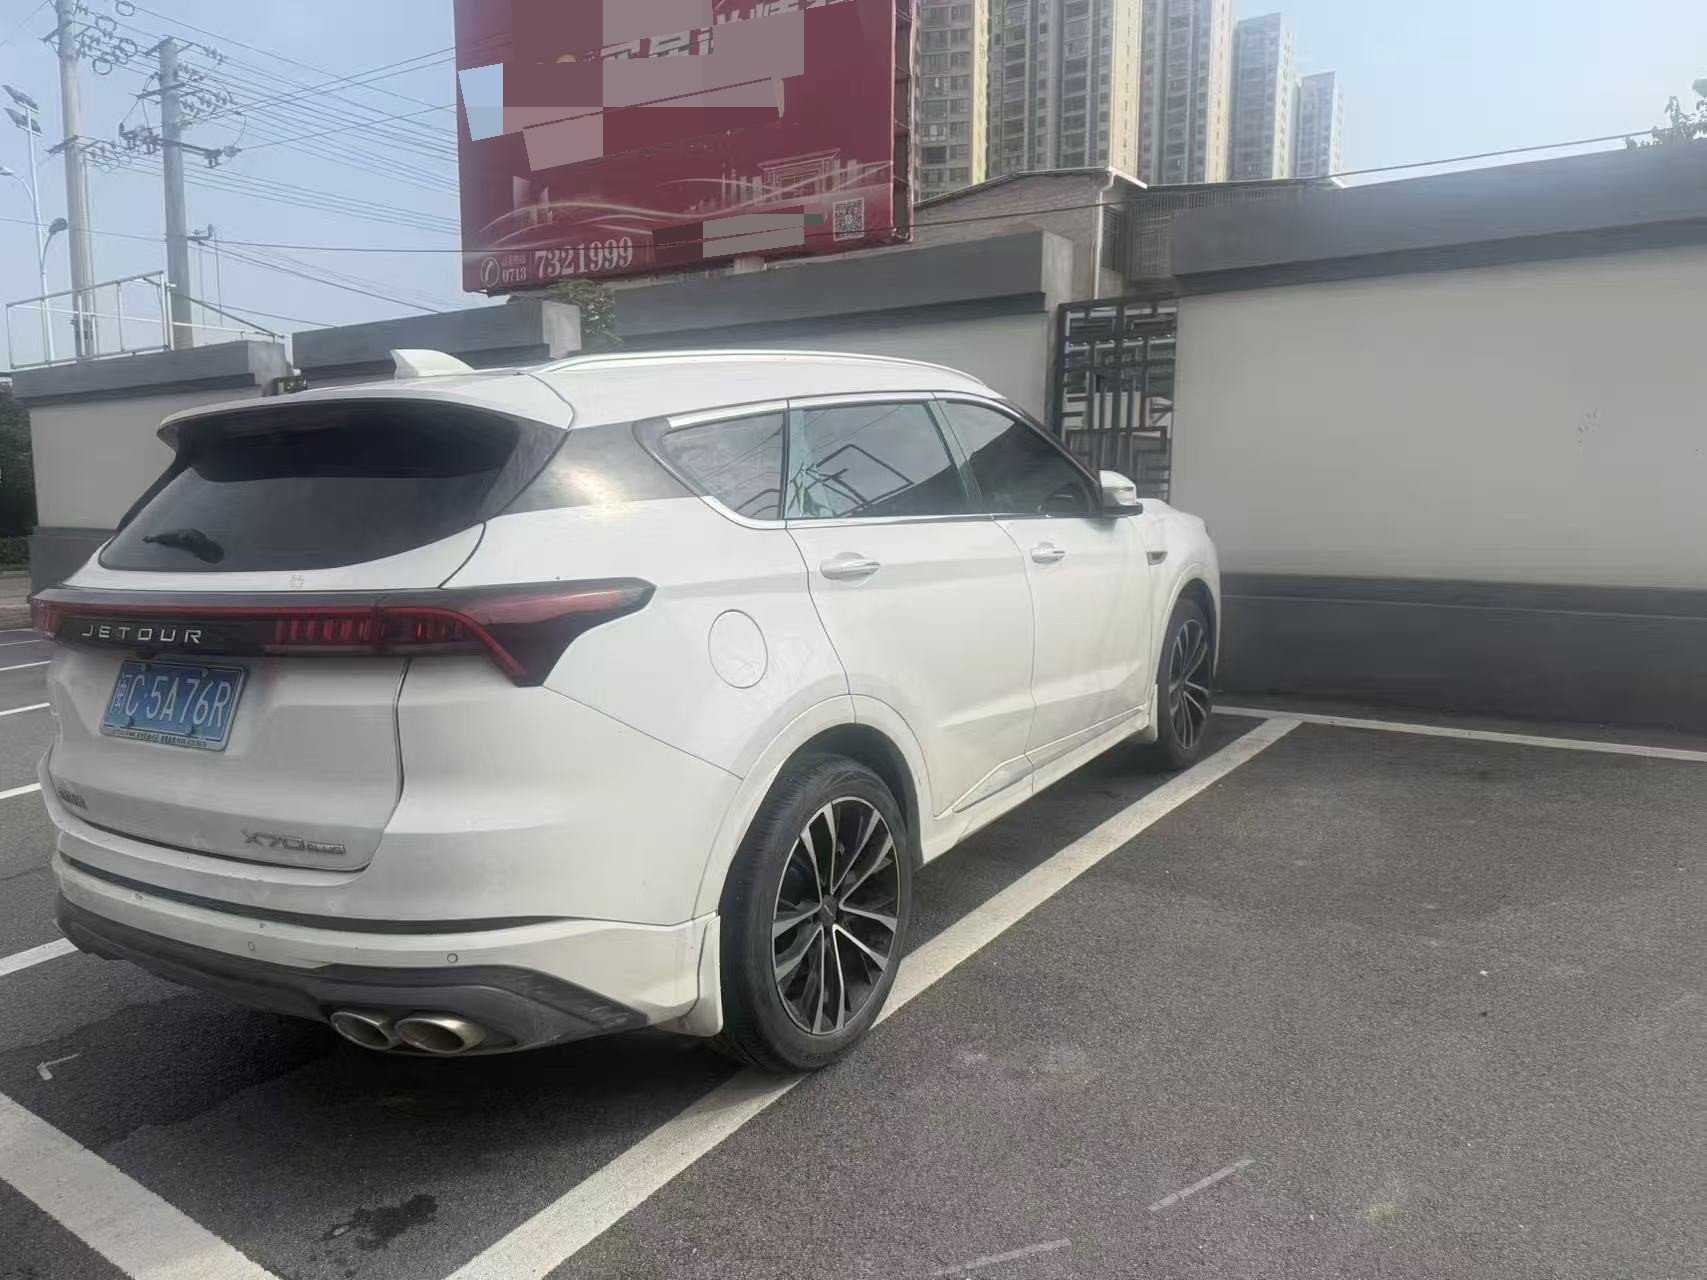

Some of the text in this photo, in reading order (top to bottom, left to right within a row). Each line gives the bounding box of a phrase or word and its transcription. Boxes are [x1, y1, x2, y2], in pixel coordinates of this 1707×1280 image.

[502, 236, 633, 283] 0713 7321999
[81, 625, 202, 644] JETOUR
